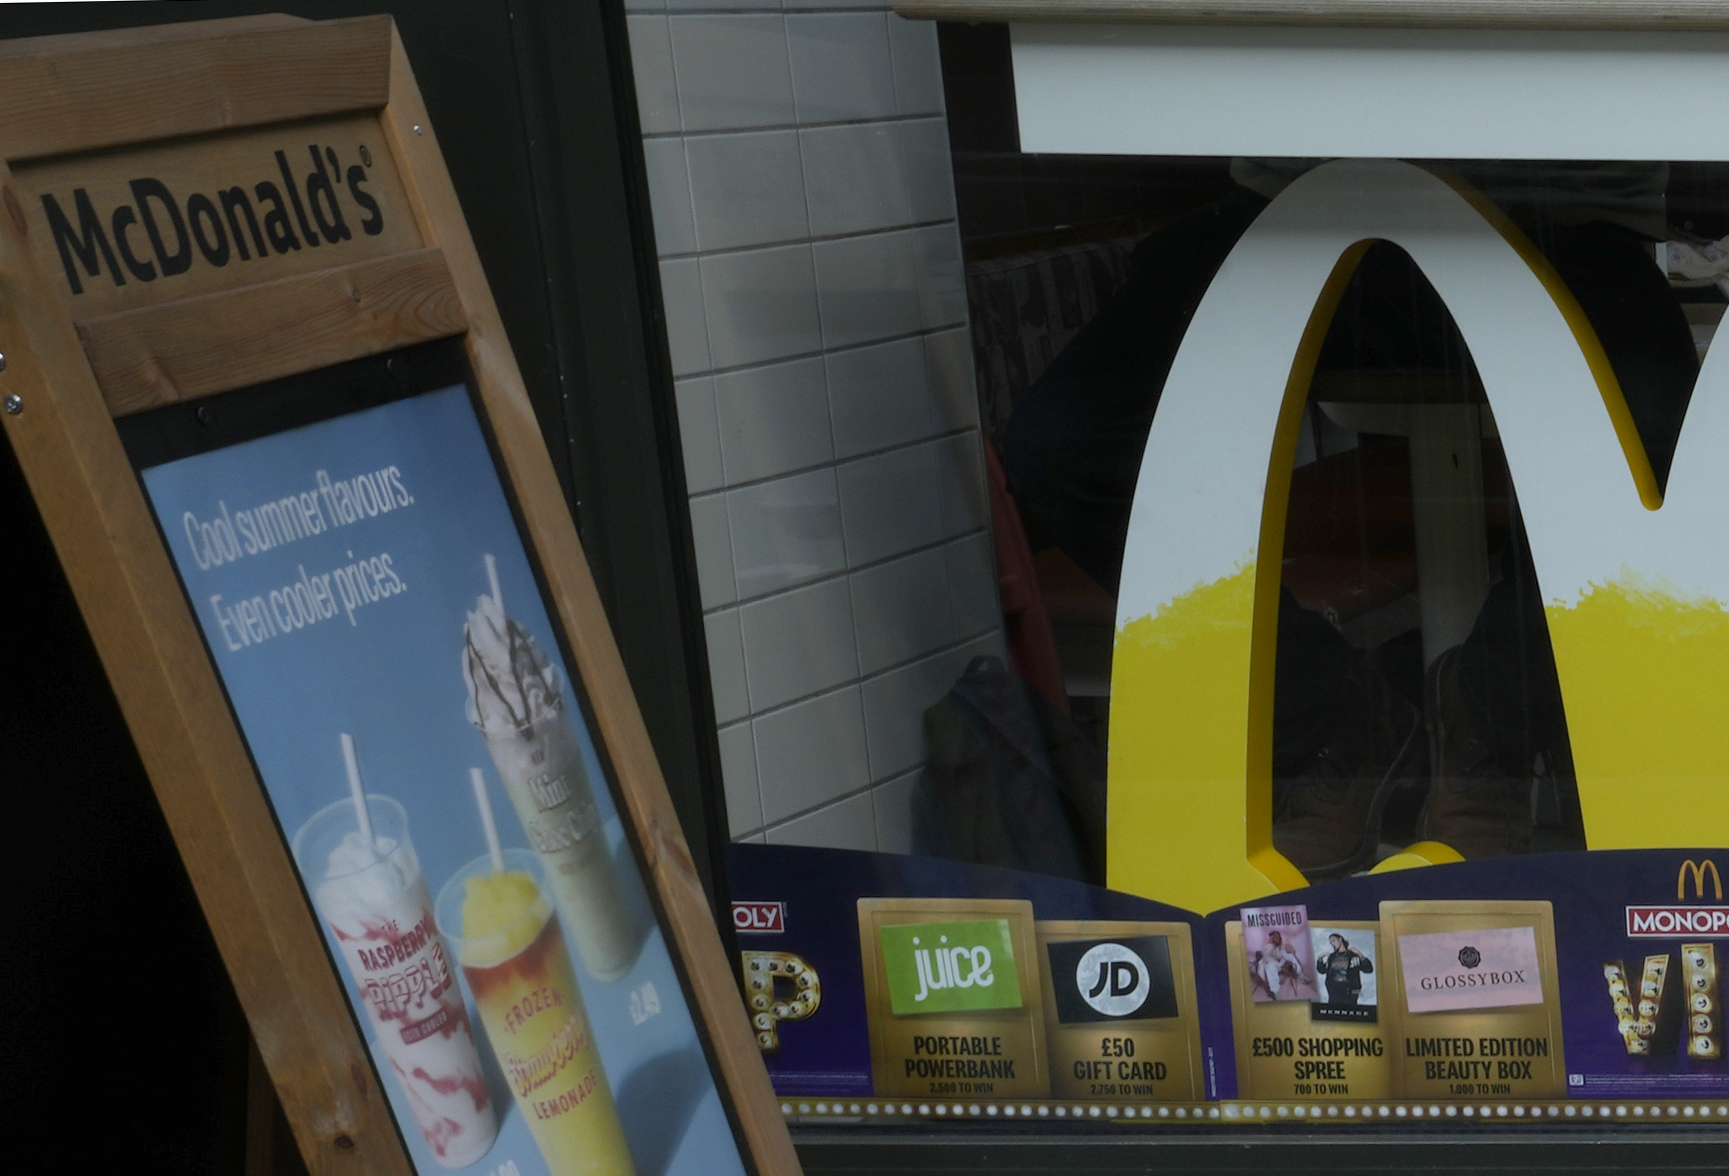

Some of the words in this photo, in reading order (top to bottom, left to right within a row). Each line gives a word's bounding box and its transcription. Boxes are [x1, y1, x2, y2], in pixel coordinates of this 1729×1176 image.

[183, 499, 244, 571] Cool
[235, 488, 328, 556] summer
[315, 465, 415, 528] flavours.
[210, 594, 277, 652] Even
[268, 564, 339, 634] cooler
[332, 550, 407, 627] prices.
[1247, 911, 1303, 928] MISSGUIDED
[357, 916, 436, 972] RASPBERRY
[913, 935, 995, 1002] juice
[1089, 961, 1140, 998] JD
[1420, 970, 1526, 991] GLOSSYBOX
[505, 986, 564, 1034] FROZEN
[913, 1036, 1002, 1055] PORTABLE
[1101, 1038, 1135, 1057] £50
[1252, 1037, 1294, 1057] £500
[1298, 1037, 1384, 1057] SHOPPING
[1406, 1037, 1475, 1057] LIMITED
[1479, 1037, 1549, 1057] EDITION
[905, 1059, 1016, 1079] POWERBANK
[1073, 1061, 1111, 1081] GIFT
[1116, 1061, 1167, 1081] CARD
[1294, 1061, 1346, 1080] SPREE
[1425, 1061, 1493, 1080] BEAUTY
[1498, 1061, 1533, 1080] BOX
[532, 1067, 598, 1120] LEMONADE
[958, 1082, 971, 1093] TO
[974, 1082, 994, 1093] WIN
[1120, 1084, 1131, 1096] TO
[1134, 1084, 1154, 1096] WIN
[1294, 1084, 1312, 1096] 700
[1315, 1084, 1326, 1096] TO
[1328, 1084, 1349, 1096] WIN
[1477, 1084, 1489, 1095] TO
[1492, 1084, 1511, 1095] WIN
